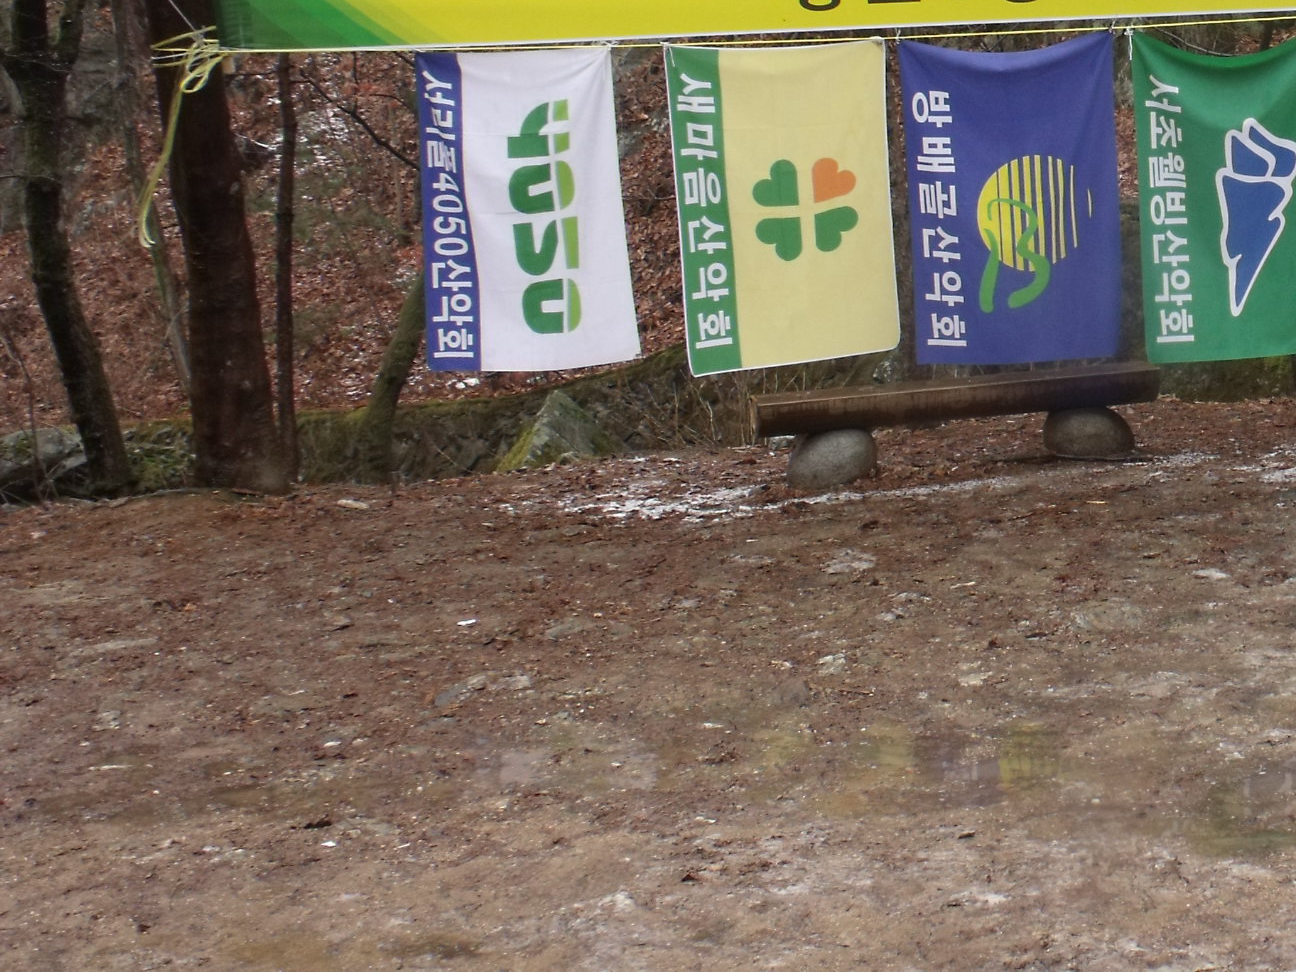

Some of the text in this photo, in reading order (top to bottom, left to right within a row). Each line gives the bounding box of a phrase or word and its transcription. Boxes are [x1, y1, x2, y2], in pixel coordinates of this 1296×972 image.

[421, 70, 474, 359] 서리풀4050산악회
[507, 99, 582, 334] 4050
[677, 73, 733, 349] 새마음산악회
[912, 90, 967, 347] 방배골산악회
[1145, 75, 1195, 343] 서초웰빙산악회
